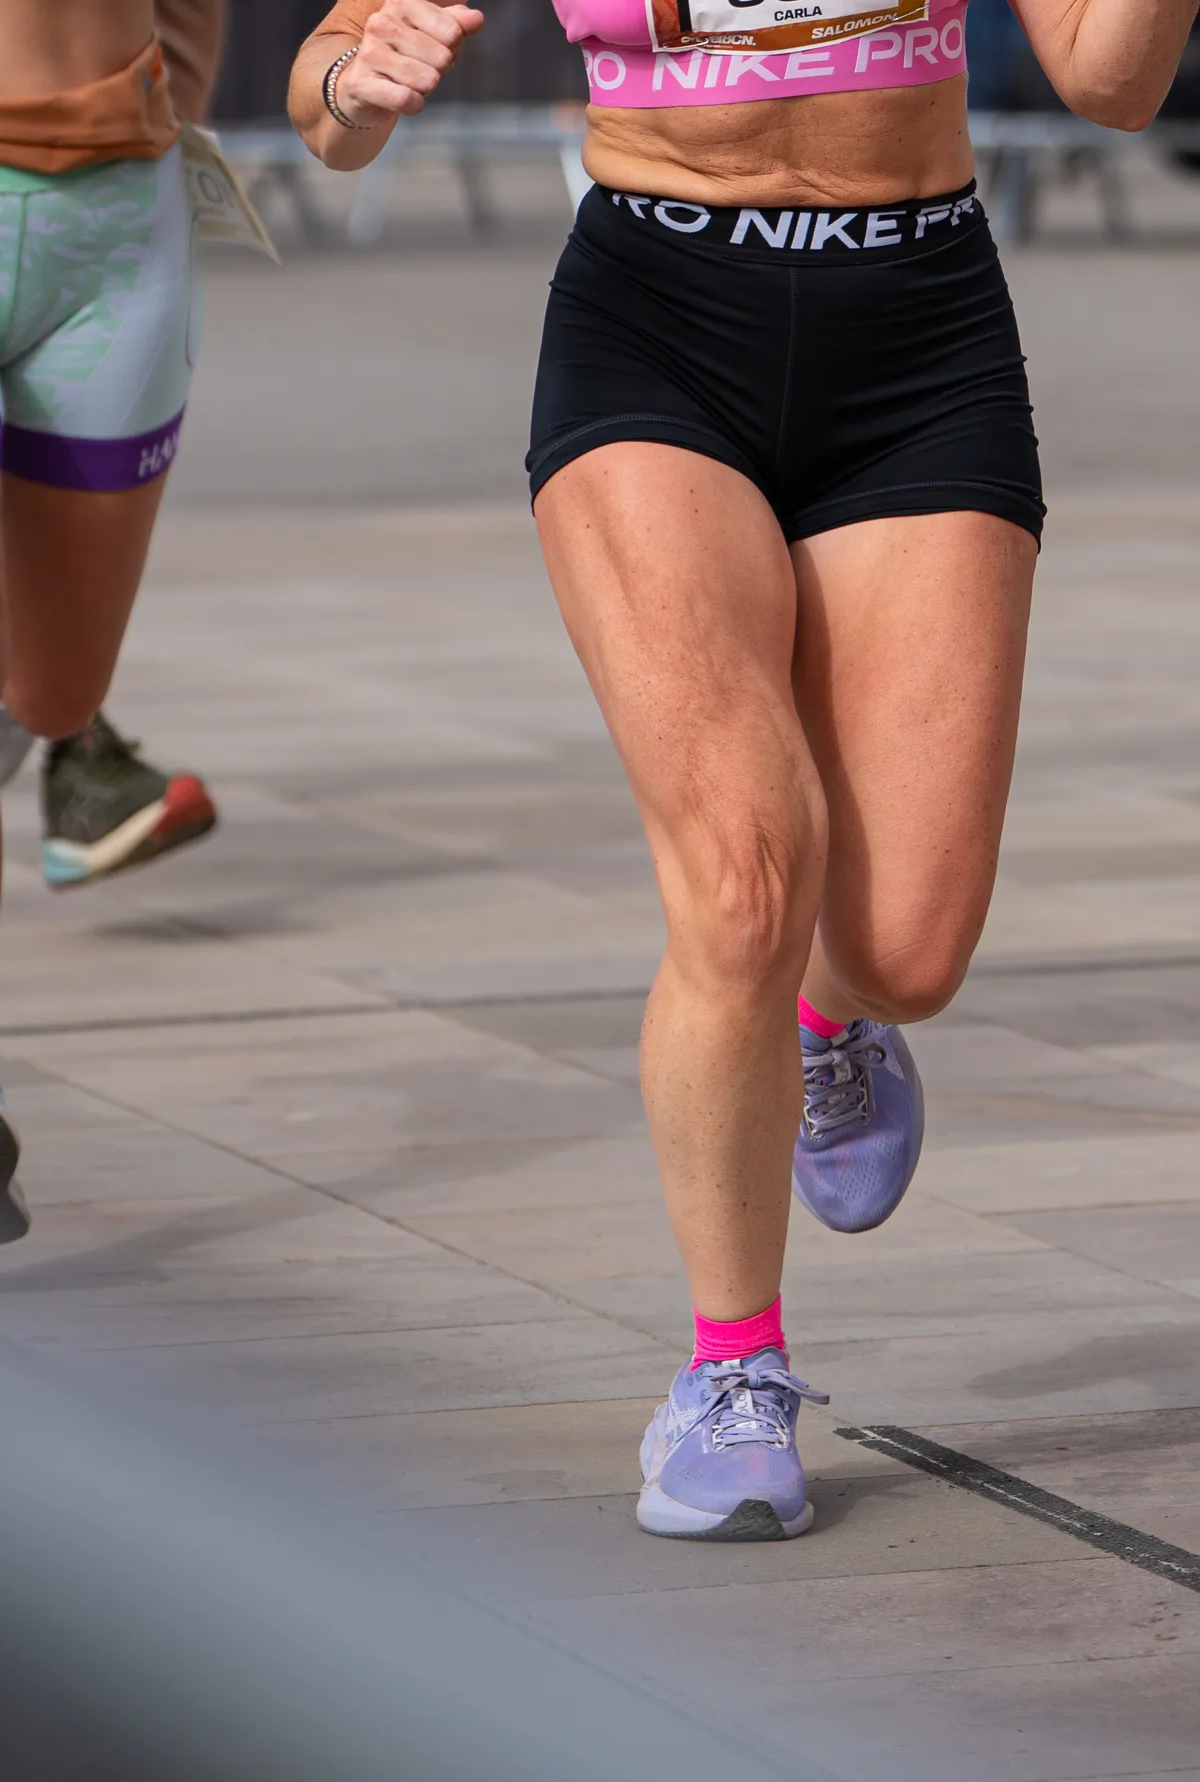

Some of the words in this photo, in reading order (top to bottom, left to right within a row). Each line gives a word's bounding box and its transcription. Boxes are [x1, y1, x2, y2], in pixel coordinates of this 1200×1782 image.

[774, 5, 823, 22] CARLA
[652, 50, 835, 91] NIKE
[855, 19, 964, 74] PRO
[729, 207, 908, 250] NIKE
